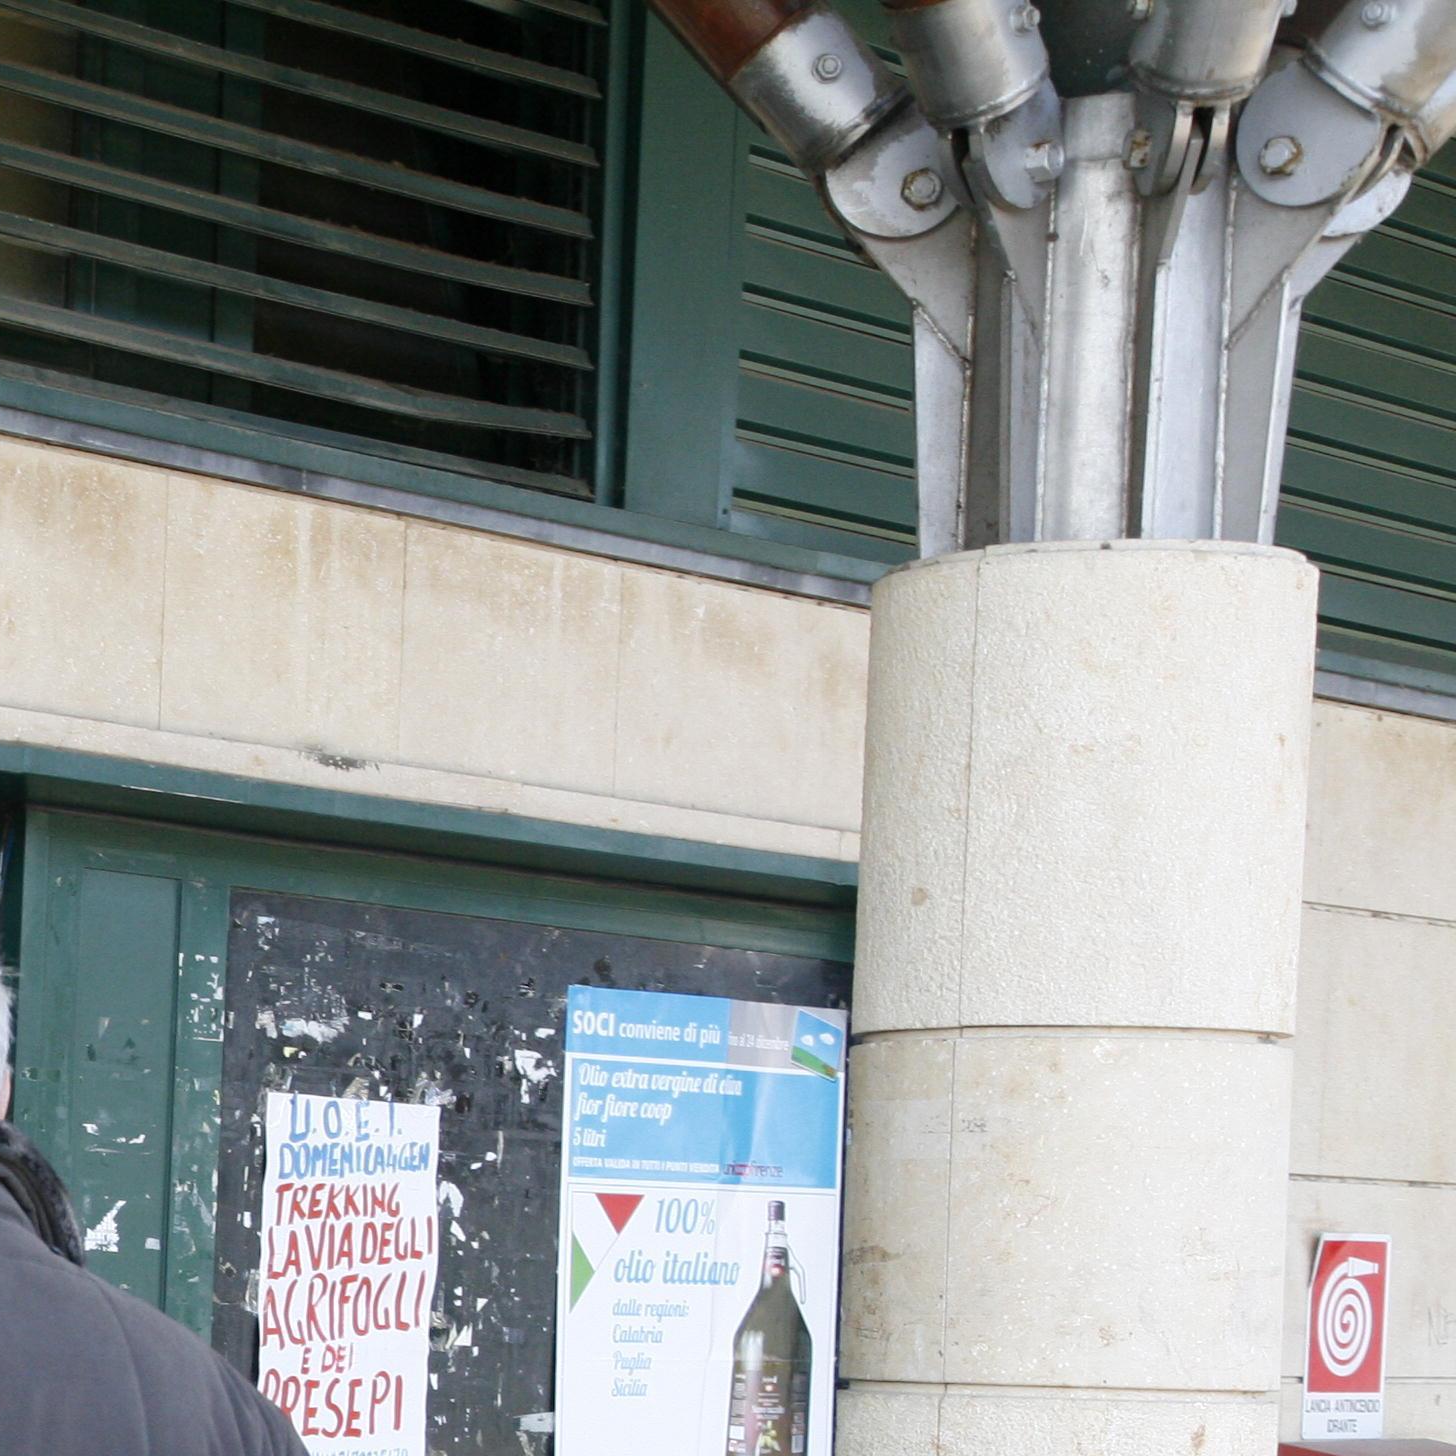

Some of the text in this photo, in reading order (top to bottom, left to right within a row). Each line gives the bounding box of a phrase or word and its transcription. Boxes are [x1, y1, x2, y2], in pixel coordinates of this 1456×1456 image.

[572, 1010, 615, 1037] SOCI
[619, 1020, 681, 1043] conviene
[684, 1022, 697, 1043] di
[700, 1024, 721, 1048] più
[578, 1063, 719, 1099] Olio extra vergine di
[574, 1091, 672, 1126] fior fiore coop
[572, 1127, 607, 1148] 5 litri
[276, 1182, 401, 1227] TREKKING
[655, 1197, 715, 1236] 100%
[359, 1216, 433, 1266] DEGLI
[614, 1250, 740, 1286] olio italiano
[261, 1270, 427, 1350] AGRIFOGLI
[612, 1299, 641, 1317] dalle
[612, 1323, 663, 1344] Calabria
[301, 1342, 354, 1374] E DEI
[611, 1377, 648, 1397] Sicilia
